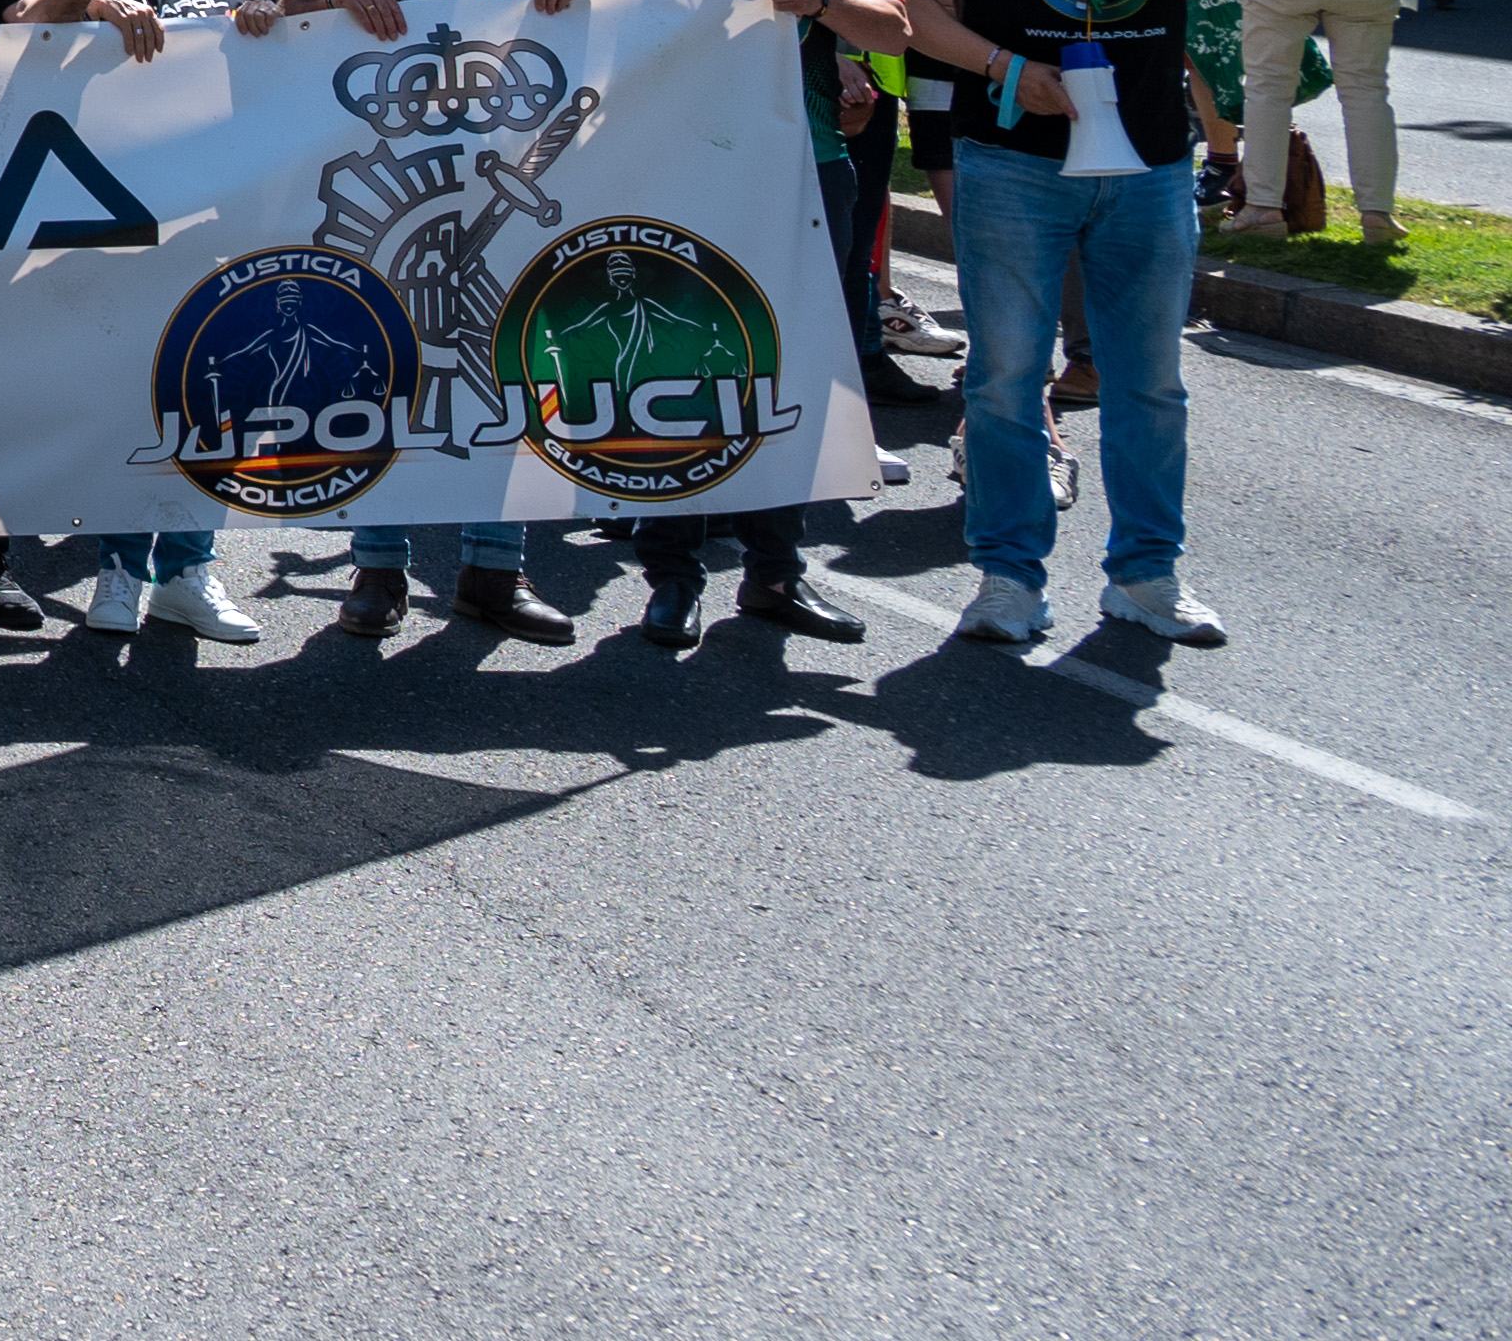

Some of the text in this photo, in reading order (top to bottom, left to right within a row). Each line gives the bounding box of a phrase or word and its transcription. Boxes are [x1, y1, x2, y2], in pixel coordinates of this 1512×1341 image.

[551, 224, 699, 271] JUSTICIA
[218, 253, 362, 298] JUSTICIA
[126, 395, 457, 466] JUPOL
[469, 374, 803, 448] JUCIL
[214, 467, 369, 507] POLICIAL
[543, 435, 750, 491] GUARDIA CIVIL
